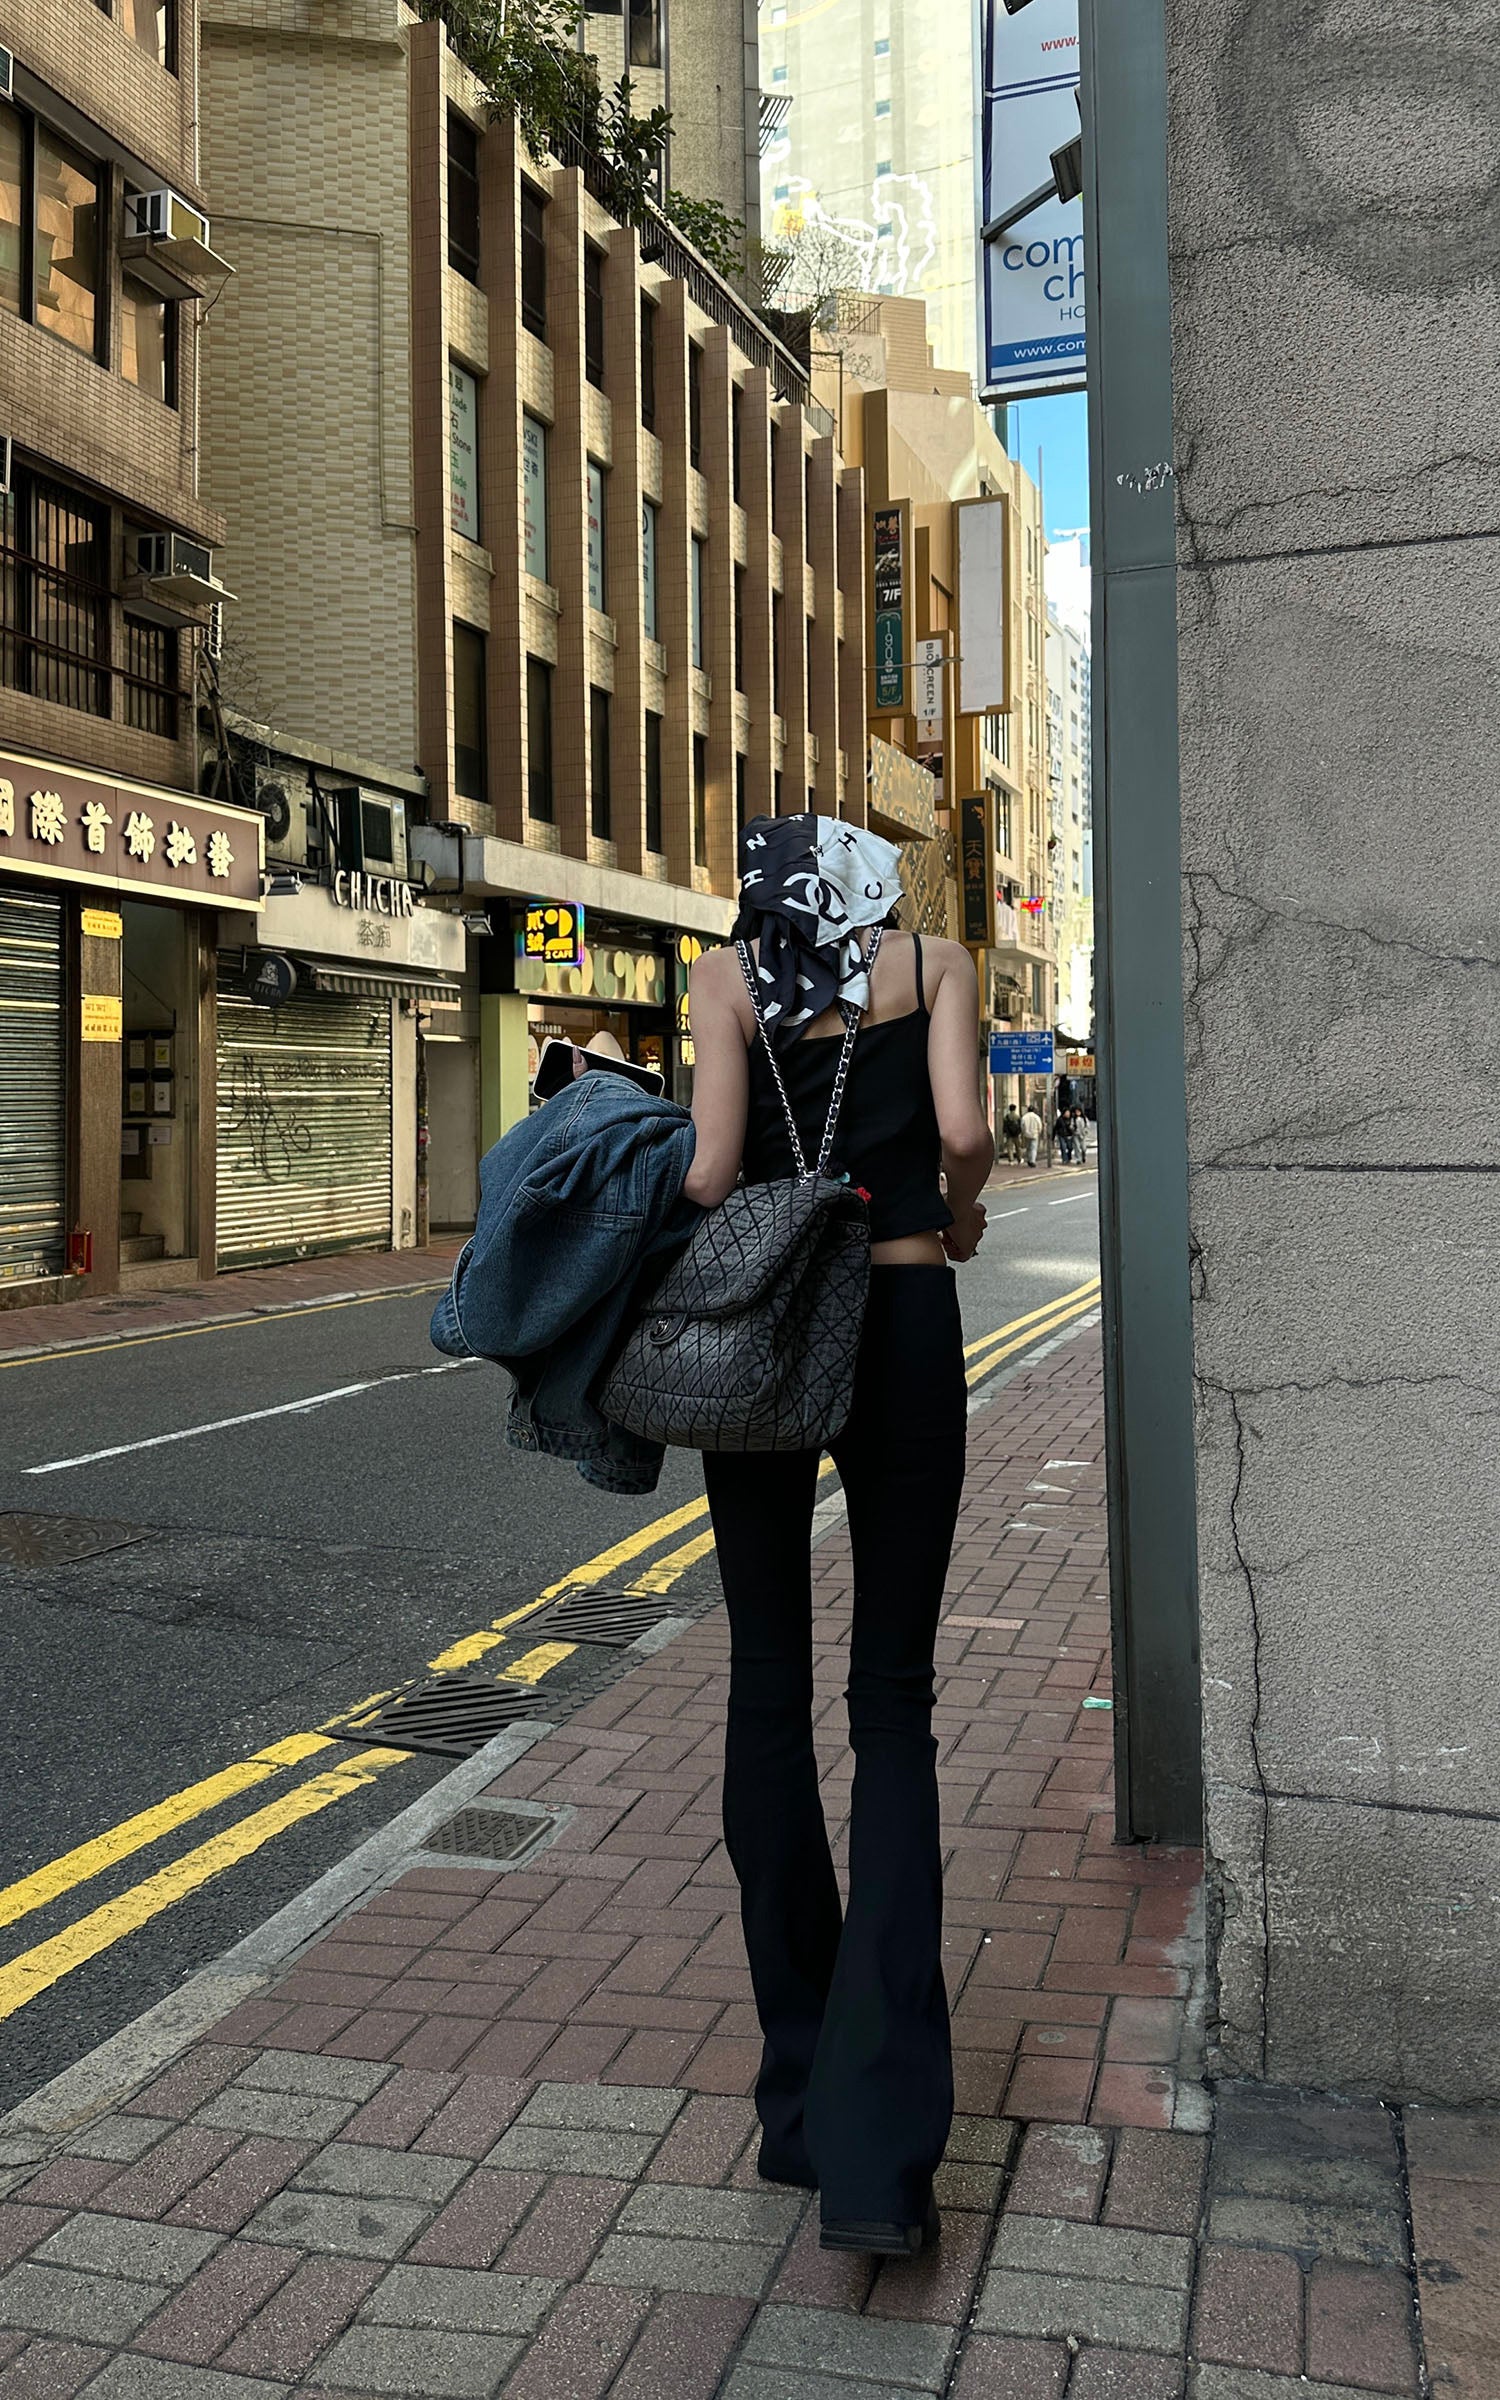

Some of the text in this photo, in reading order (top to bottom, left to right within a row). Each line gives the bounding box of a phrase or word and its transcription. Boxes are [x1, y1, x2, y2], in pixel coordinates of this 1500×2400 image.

[451, 432, 473, 455] Stone
[883, 588, 902, 602] 7/F
[925, 641, 935, 706] BIOCREEN
[332, 869, 414, 918] CHICHA
[552, 949, 573, 958] CAFE
